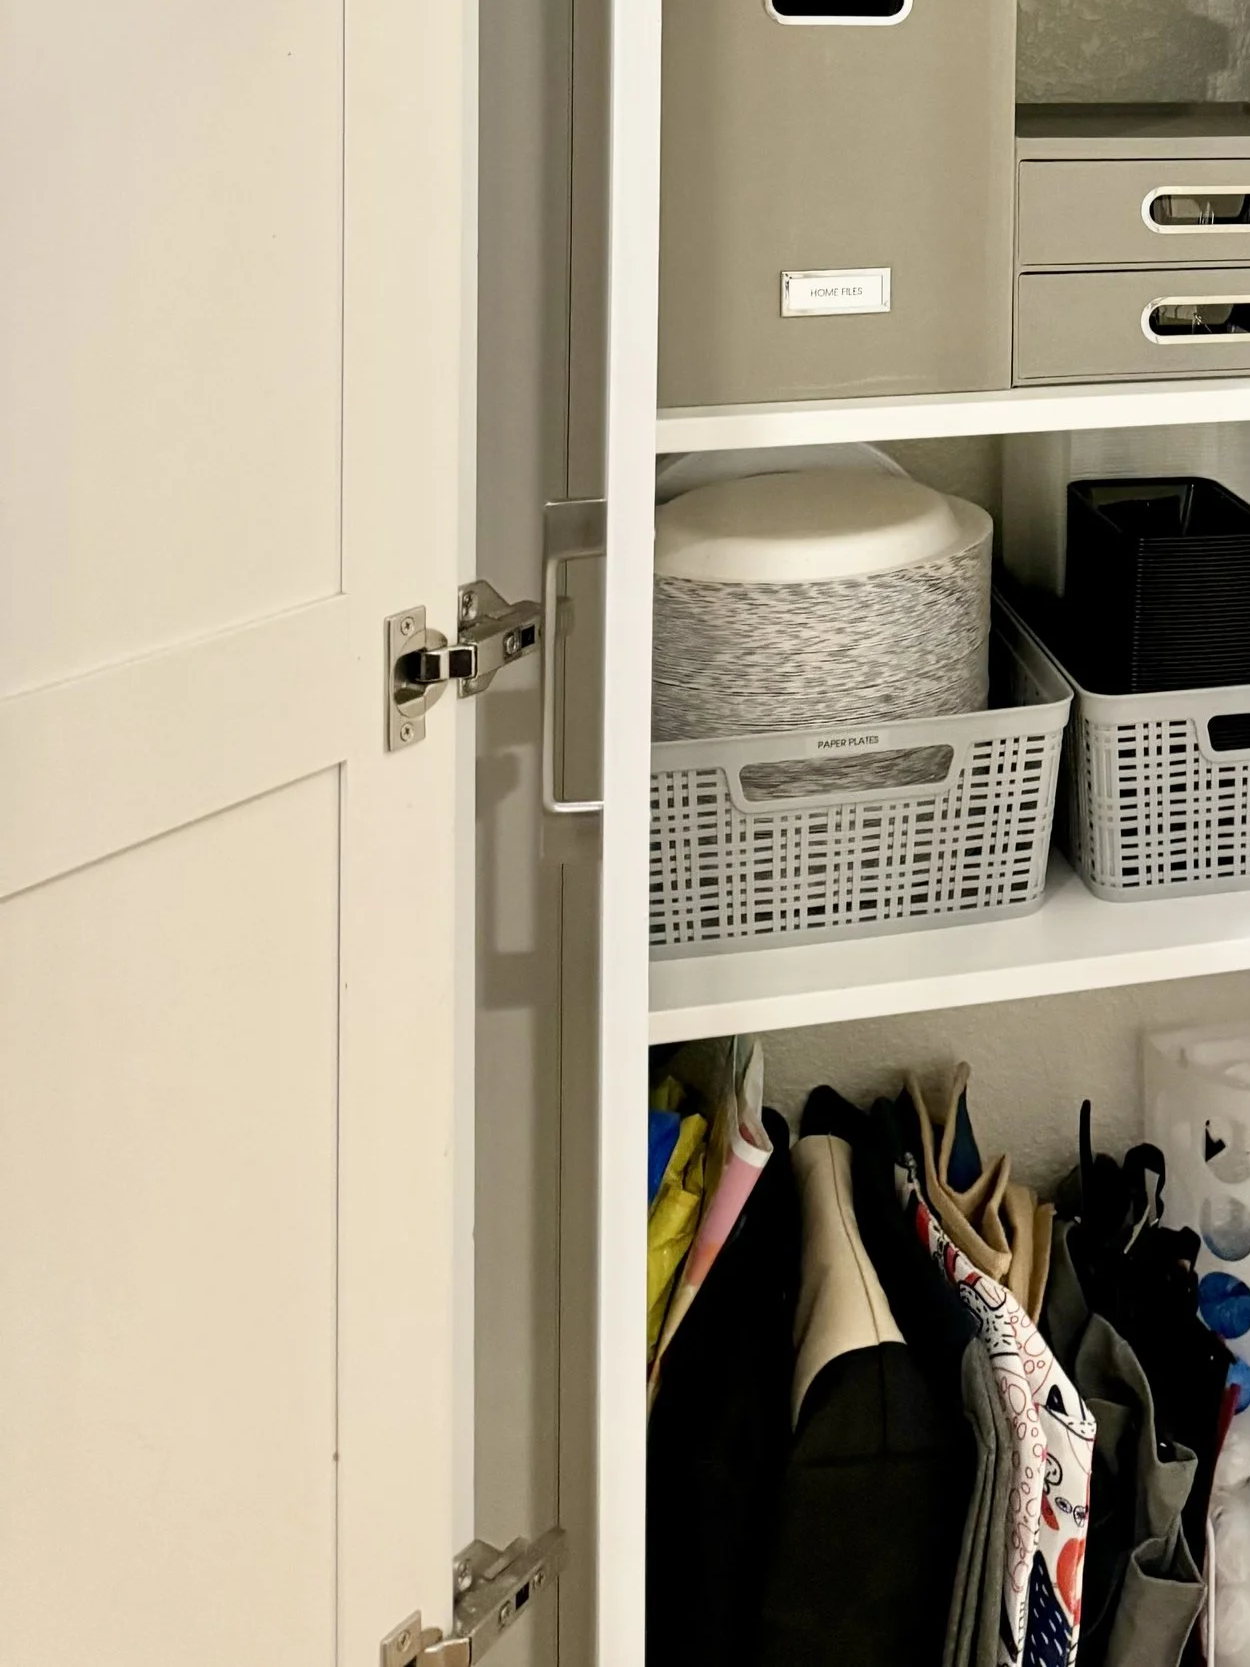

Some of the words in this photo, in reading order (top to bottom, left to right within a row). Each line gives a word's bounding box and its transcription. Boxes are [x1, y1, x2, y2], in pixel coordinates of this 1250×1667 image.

[810, 287, 839, 297] HOME
[841, 287, 863, 296] FILES
[818, 738, 847, 749] PAPER
[848, 735, 879, 746] PLATES
